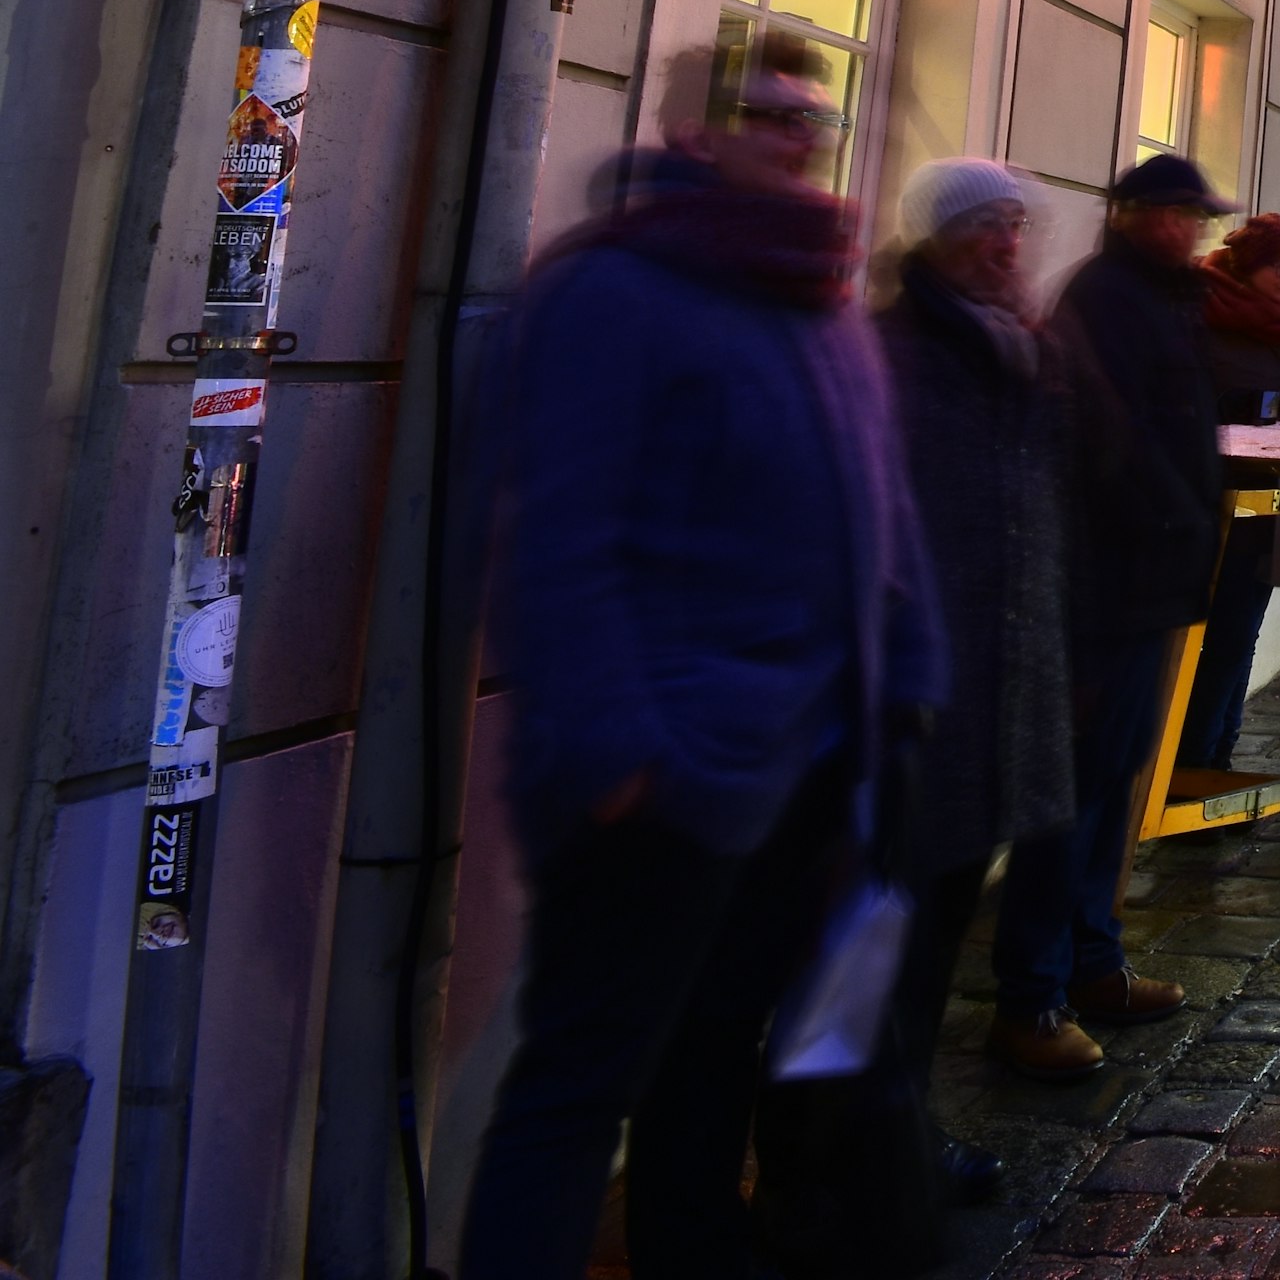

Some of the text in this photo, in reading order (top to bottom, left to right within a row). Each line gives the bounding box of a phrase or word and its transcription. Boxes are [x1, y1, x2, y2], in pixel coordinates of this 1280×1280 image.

[230, 158, 282, 174] SODOM
[213, 231, 266, 246] LEBEN
[208, 400, 236, 414] SEIN
[148, 813, 180, 896] razzz
